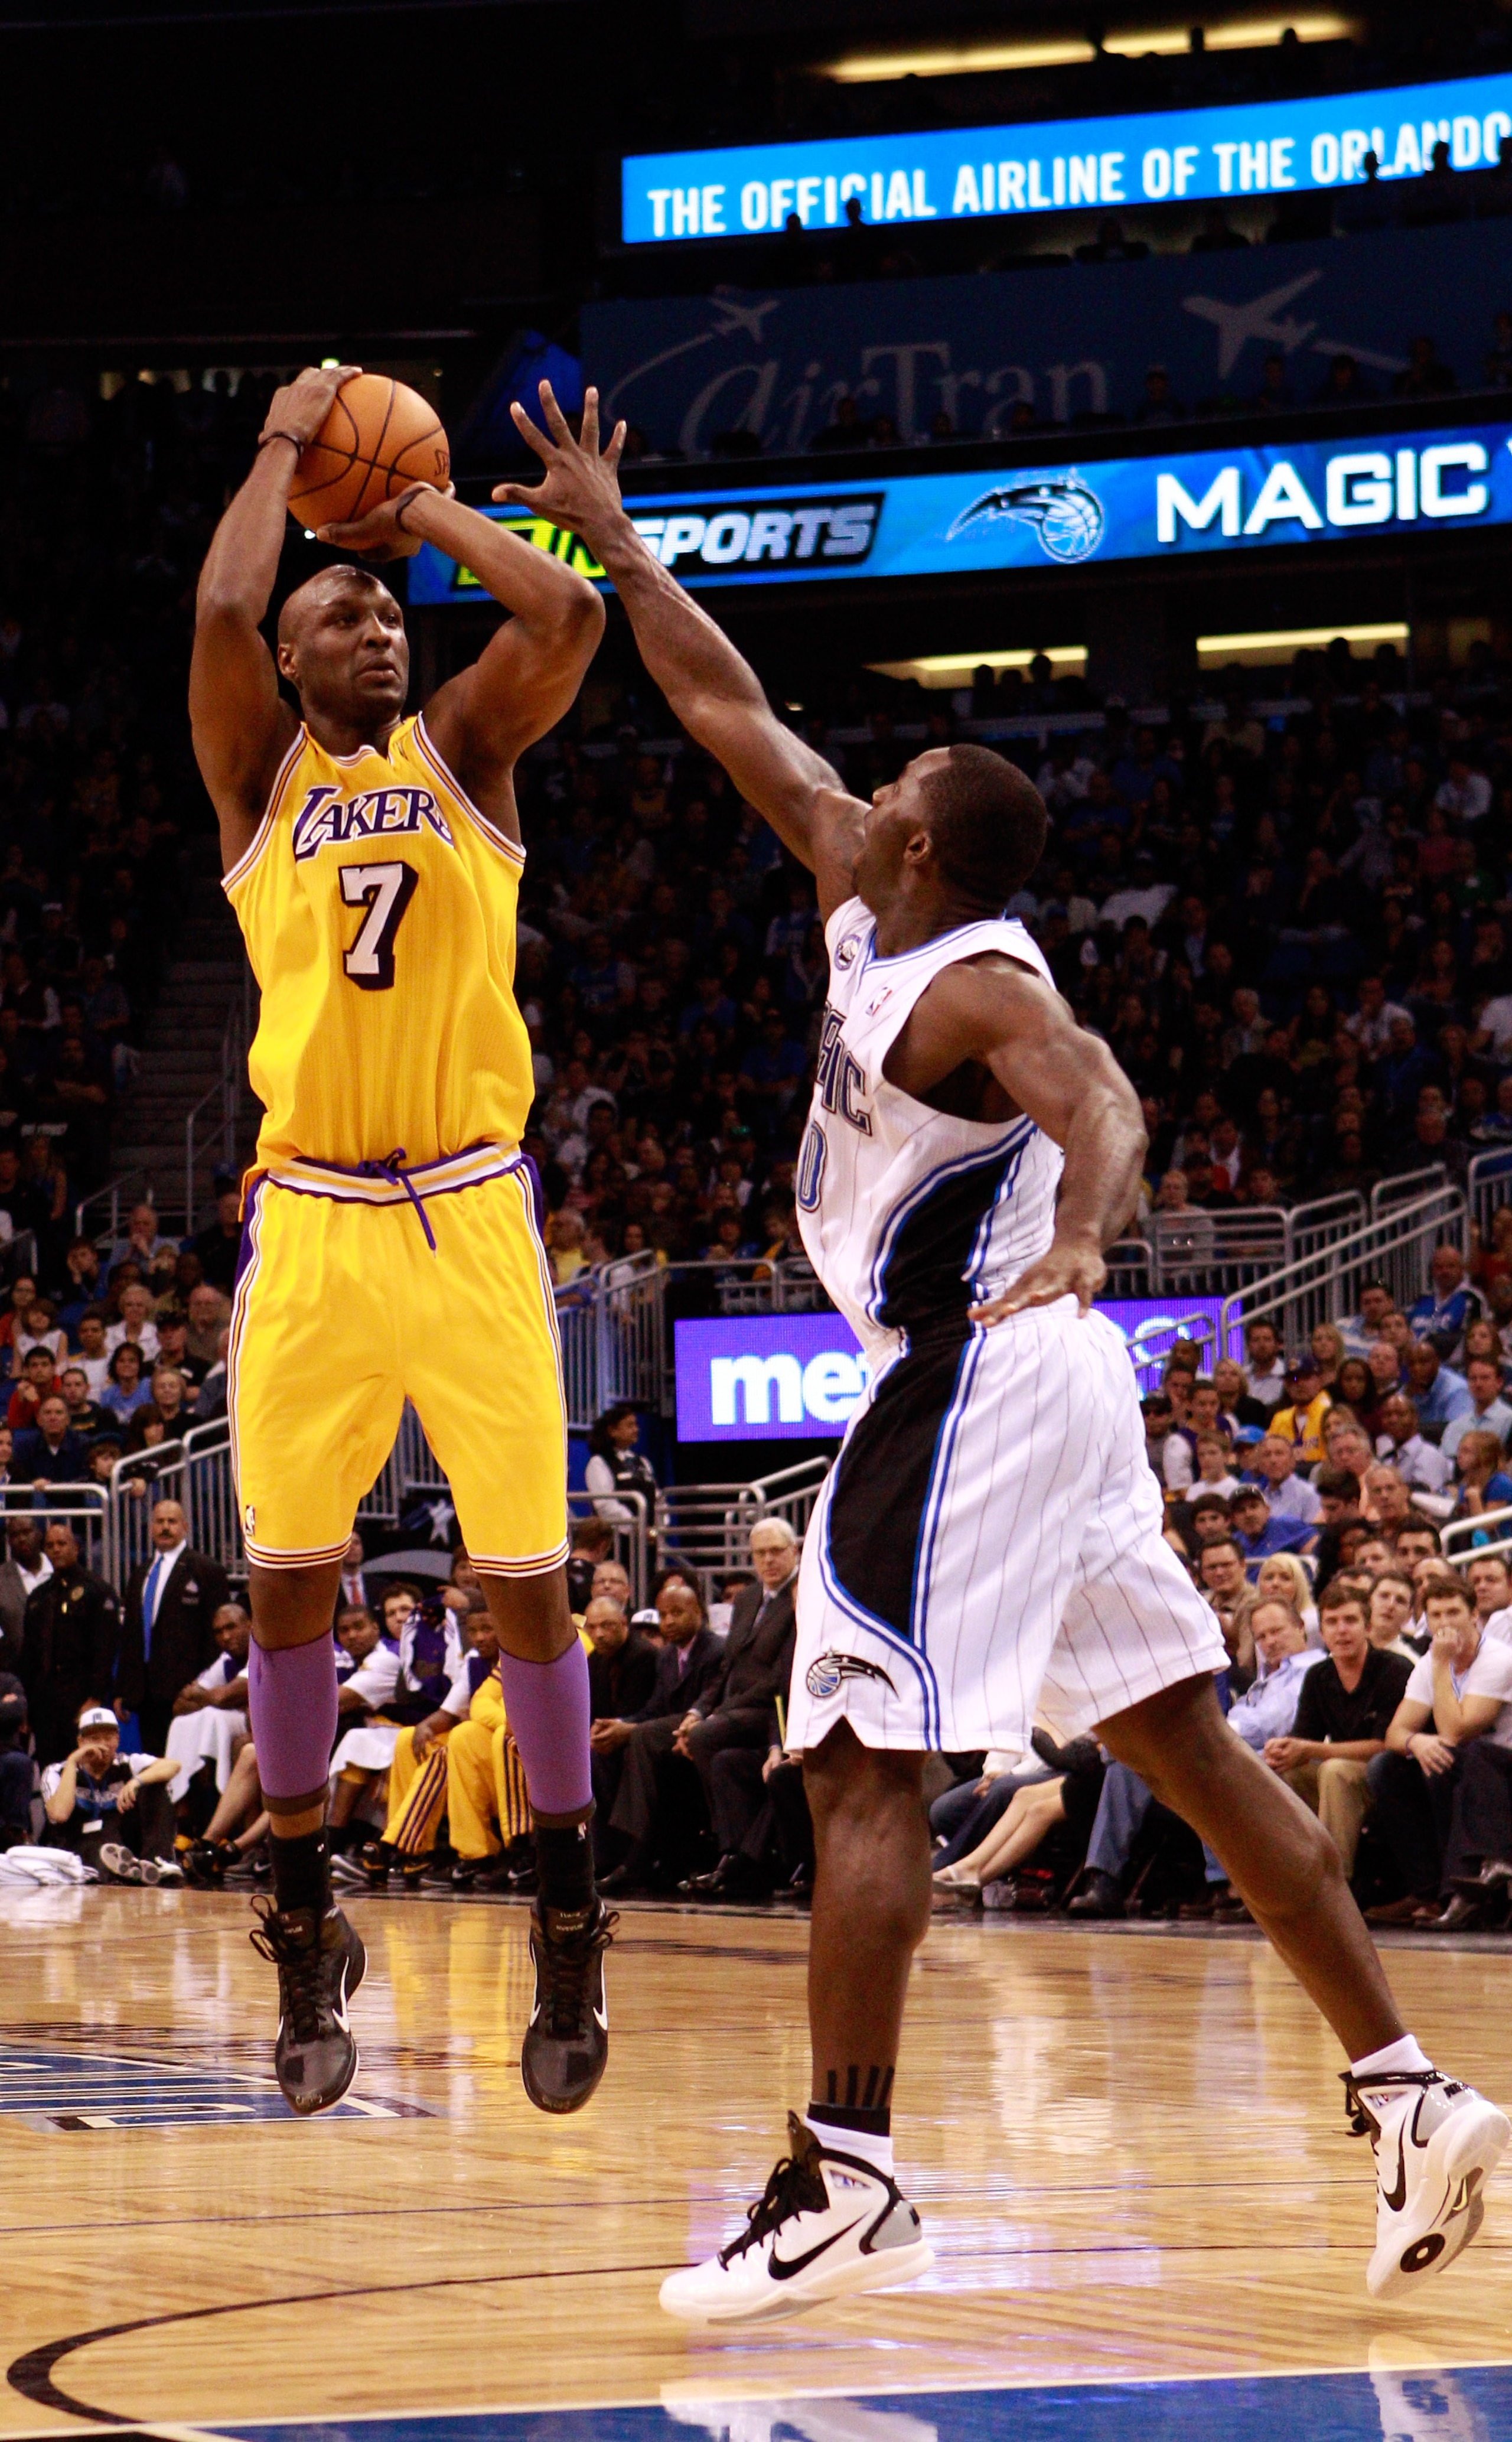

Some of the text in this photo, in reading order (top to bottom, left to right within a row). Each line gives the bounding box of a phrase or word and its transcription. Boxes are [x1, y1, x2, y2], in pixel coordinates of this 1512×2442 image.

[647, 184, 726, 237] THE
[741, 169, 937, 231] OFFICIAL
[952, 151, 1126, 214] AIRLINE
[1142, 146, 1200, 198] OF
[1212, 136, 1296, 193] THE
[630, 503, 875, 567] SPORTS
[1156, 442, 1488, 543] MAGIC
[338, 861, 419, 991] 7
